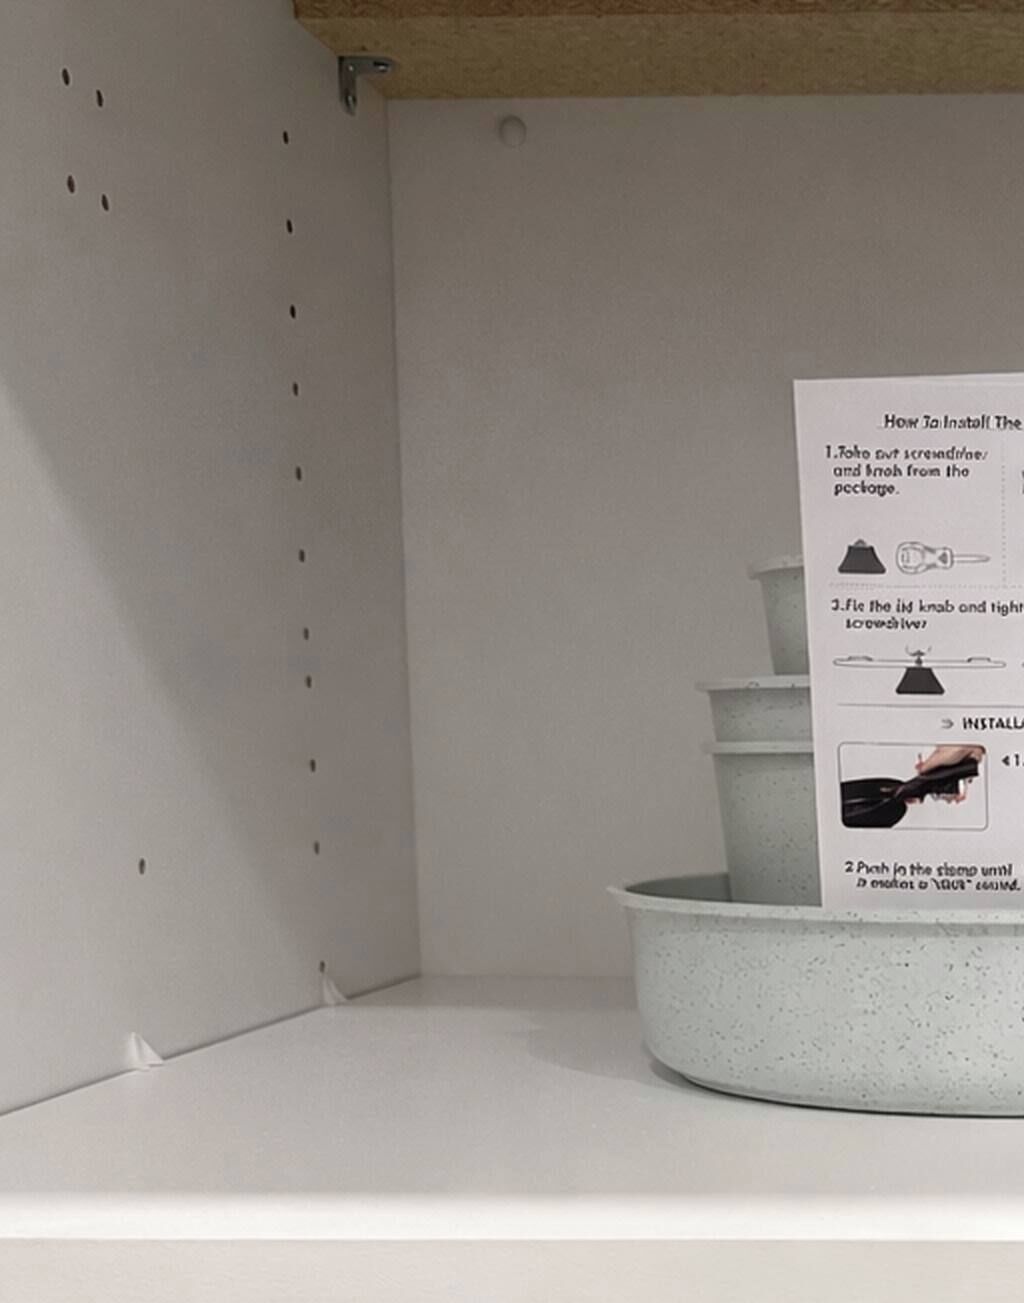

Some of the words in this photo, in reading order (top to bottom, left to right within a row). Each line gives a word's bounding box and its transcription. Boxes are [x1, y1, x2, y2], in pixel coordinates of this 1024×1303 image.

[884, 414, 919, 429] How
[994, 415, 1022, 430] The
[907, 464, 940, 477] from
